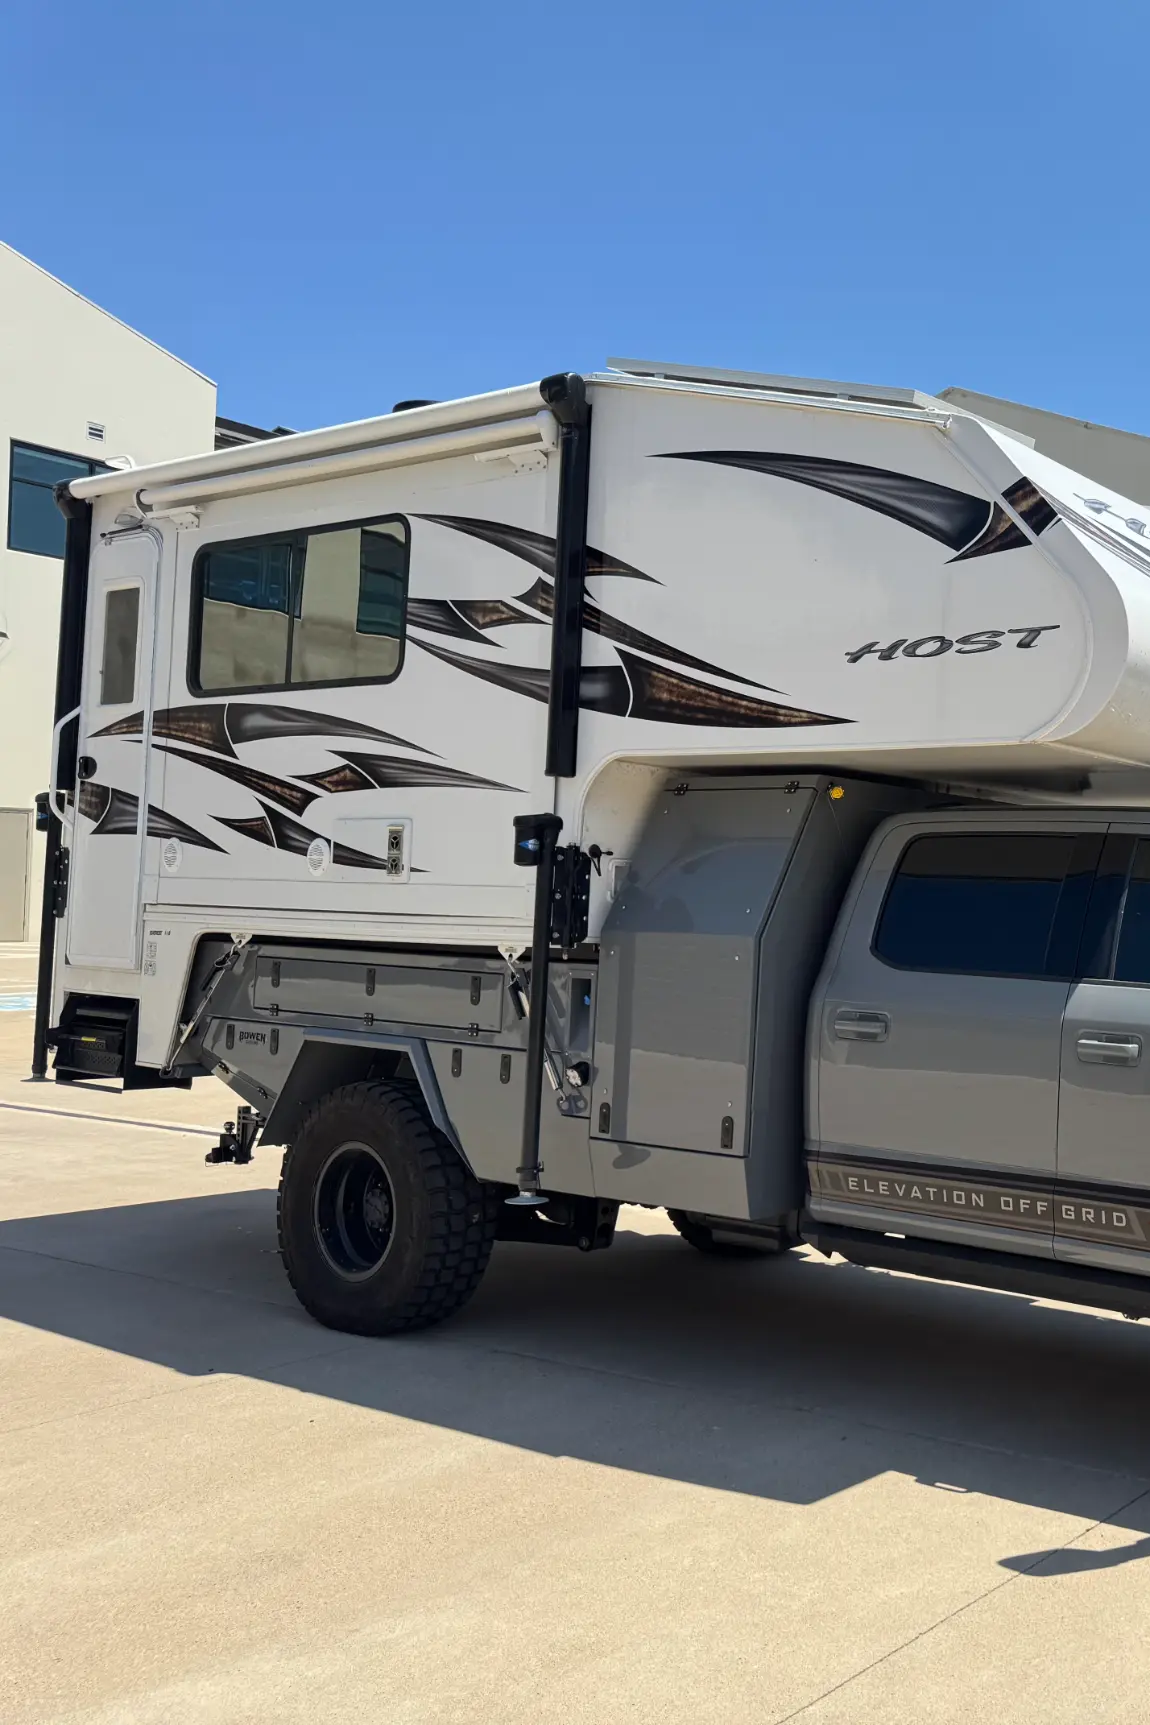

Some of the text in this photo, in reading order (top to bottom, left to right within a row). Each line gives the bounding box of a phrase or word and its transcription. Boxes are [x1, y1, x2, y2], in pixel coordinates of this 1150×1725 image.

[845, 624, 1061, 664] HOST
[239, 1031, 266, 1045] BOWEN
[848, 1176, 1127, 1227] ELEVATION OFF GRID
